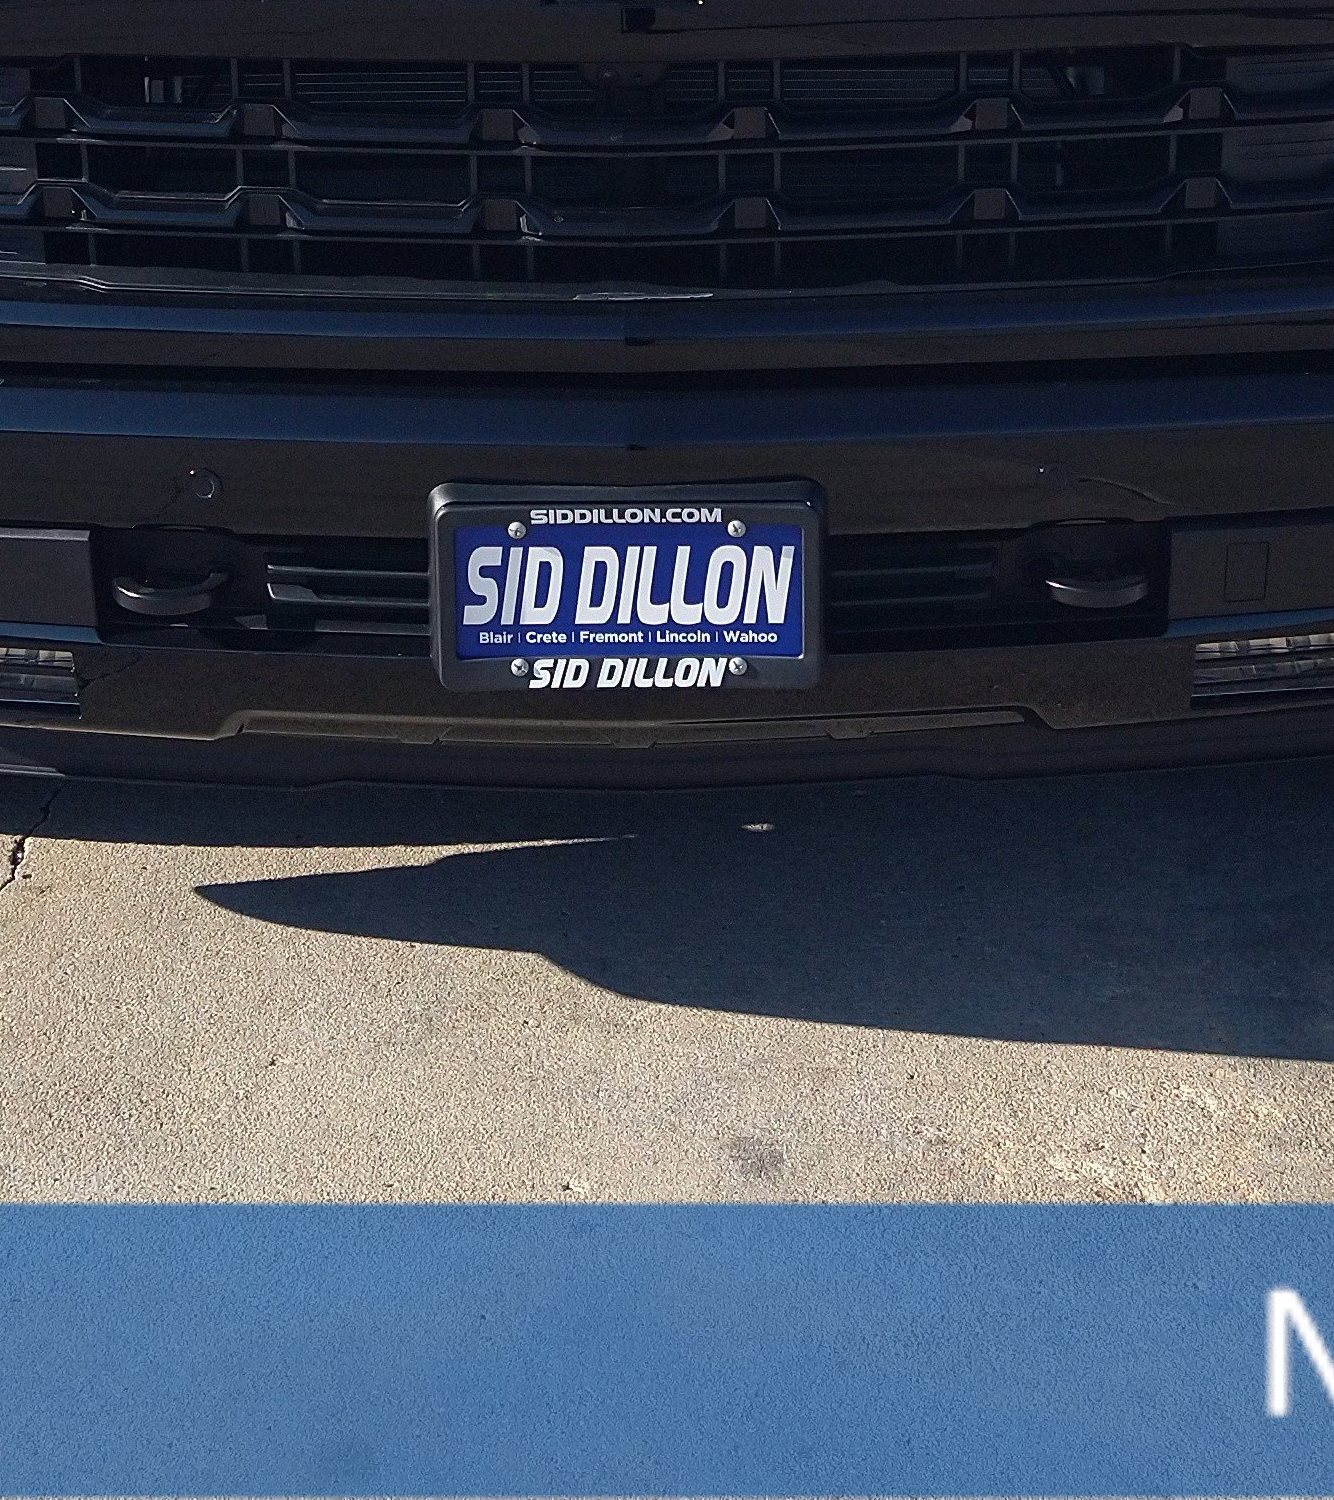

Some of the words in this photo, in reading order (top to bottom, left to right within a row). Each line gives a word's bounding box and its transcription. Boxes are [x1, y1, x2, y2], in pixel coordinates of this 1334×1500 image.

[529, 507, 723, 525] SIDDILLON.COM
[462, 545, 564, 626] SID
[574, 544, 795, 626] DILLON
[478, 630, 514, 644] Blair
[525, 630, 568, 644] Crete
[579, 630, 645, 644] Fremont
[656, 629, 711, 643] Lincoln
[722, 629, 778, 643] Wahoo
[528, 657, 591, 689] SID
[596, 656, 727, 689] DILLON
